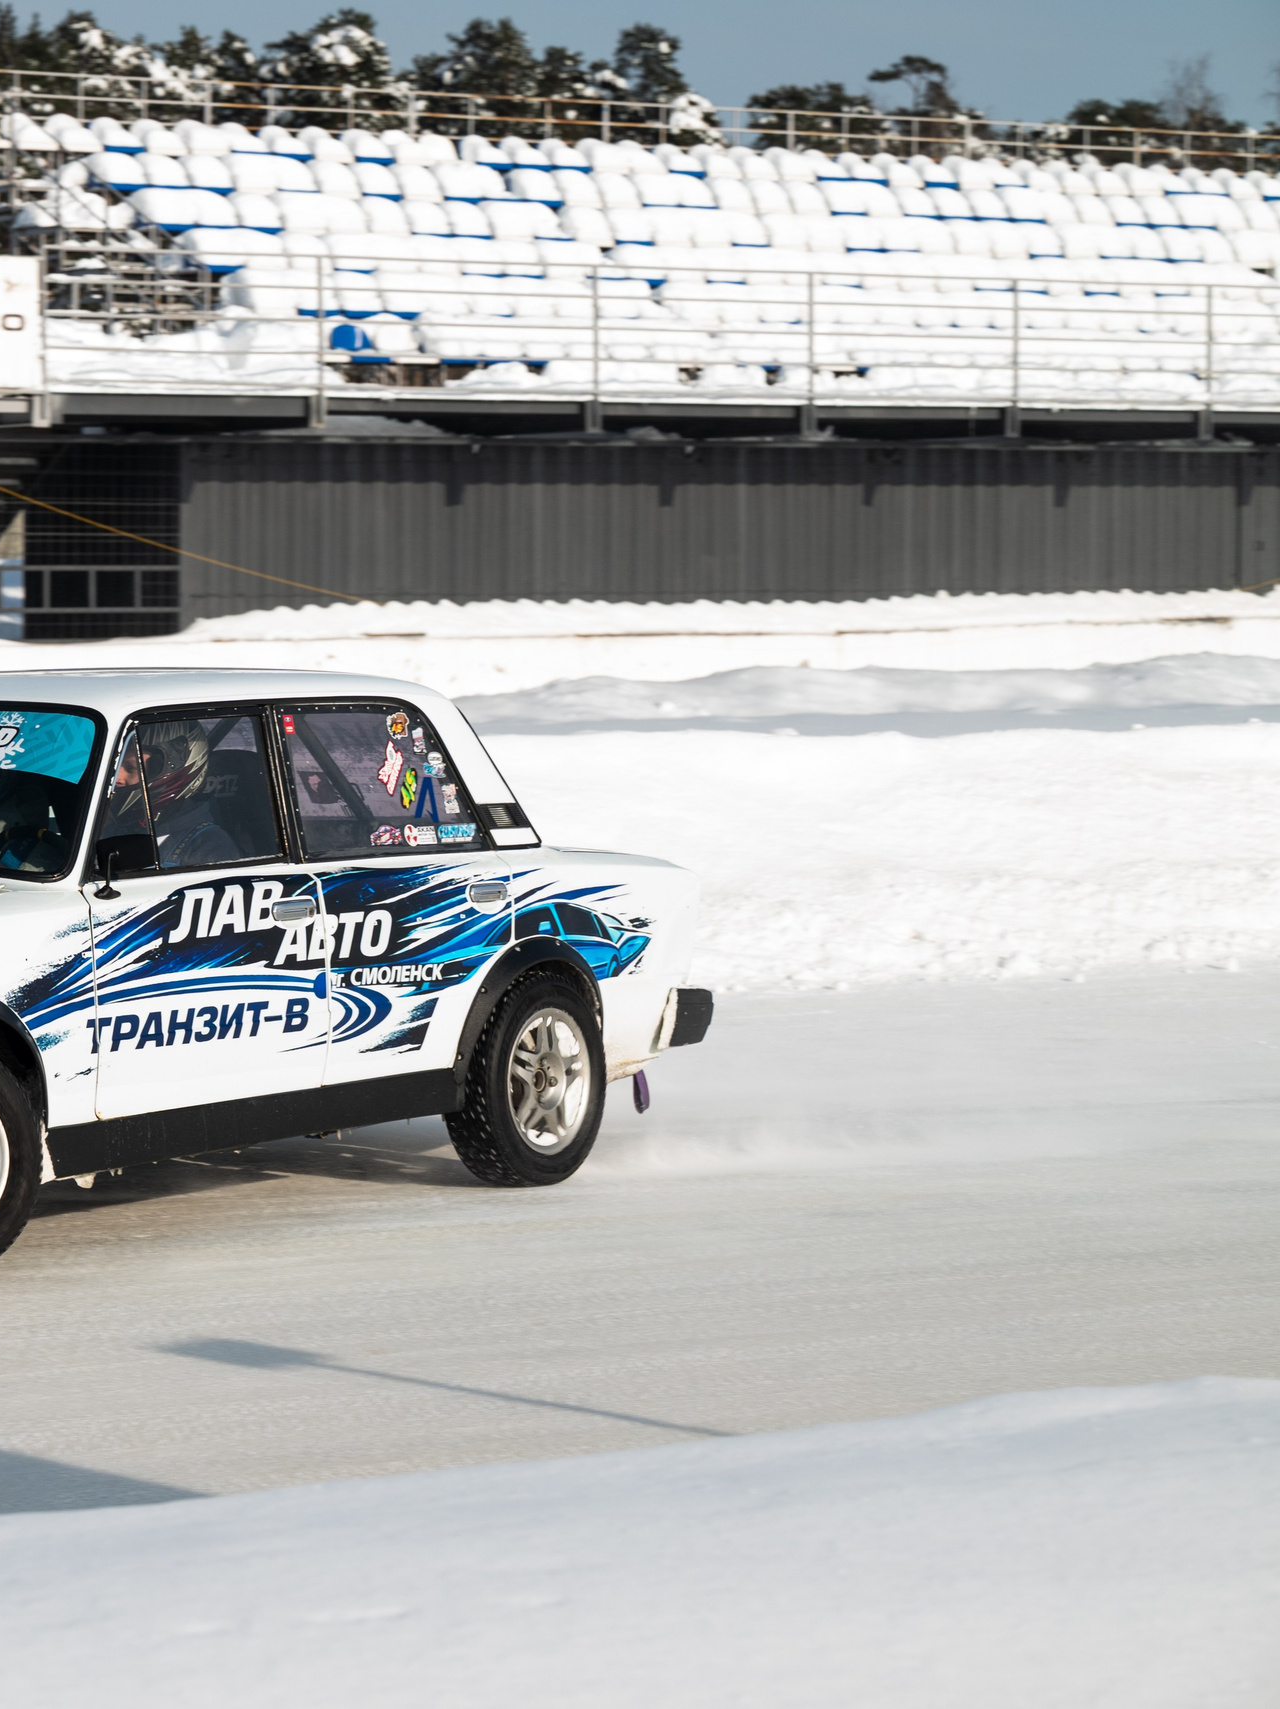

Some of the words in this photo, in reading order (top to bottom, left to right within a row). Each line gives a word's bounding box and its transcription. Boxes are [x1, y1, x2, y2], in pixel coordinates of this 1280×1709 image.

[168, 879, 284, 944] ЛАВ
[274, 908, 392, 967] АВТО
[351, 963, 444, 987] СМОЛЕНСК
[85, 996, 310, 1054] ТРАНЗИТ-В
